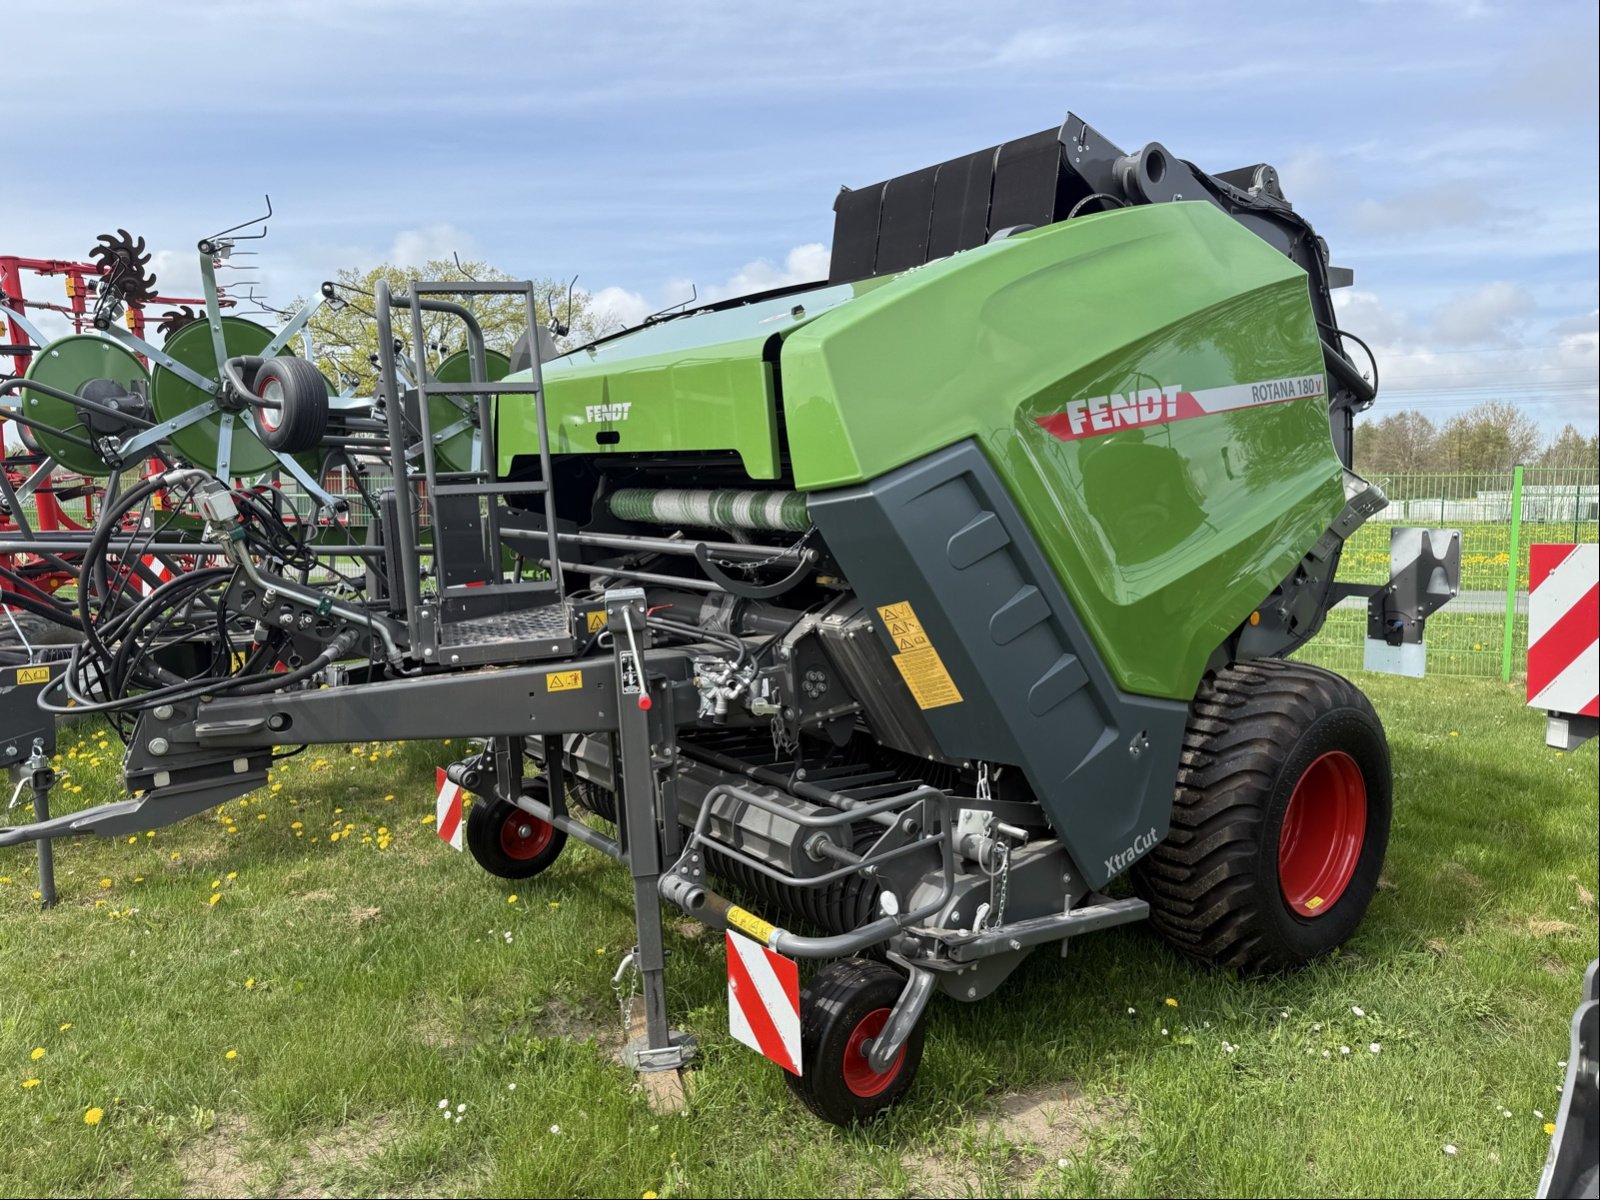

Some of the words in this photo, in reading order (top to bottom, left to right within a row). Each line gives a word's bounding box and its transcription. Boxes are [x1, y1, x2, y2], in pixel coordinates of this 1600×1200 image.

[585, 402, 632, 423] FENDT
[1066, 384, 1182, 435] FENDT
[1252, 381, 1295, 403] ROTANA
[1296, 378, 1315, 396] 180
[1104, 826, 1158, 878] XtraCut
